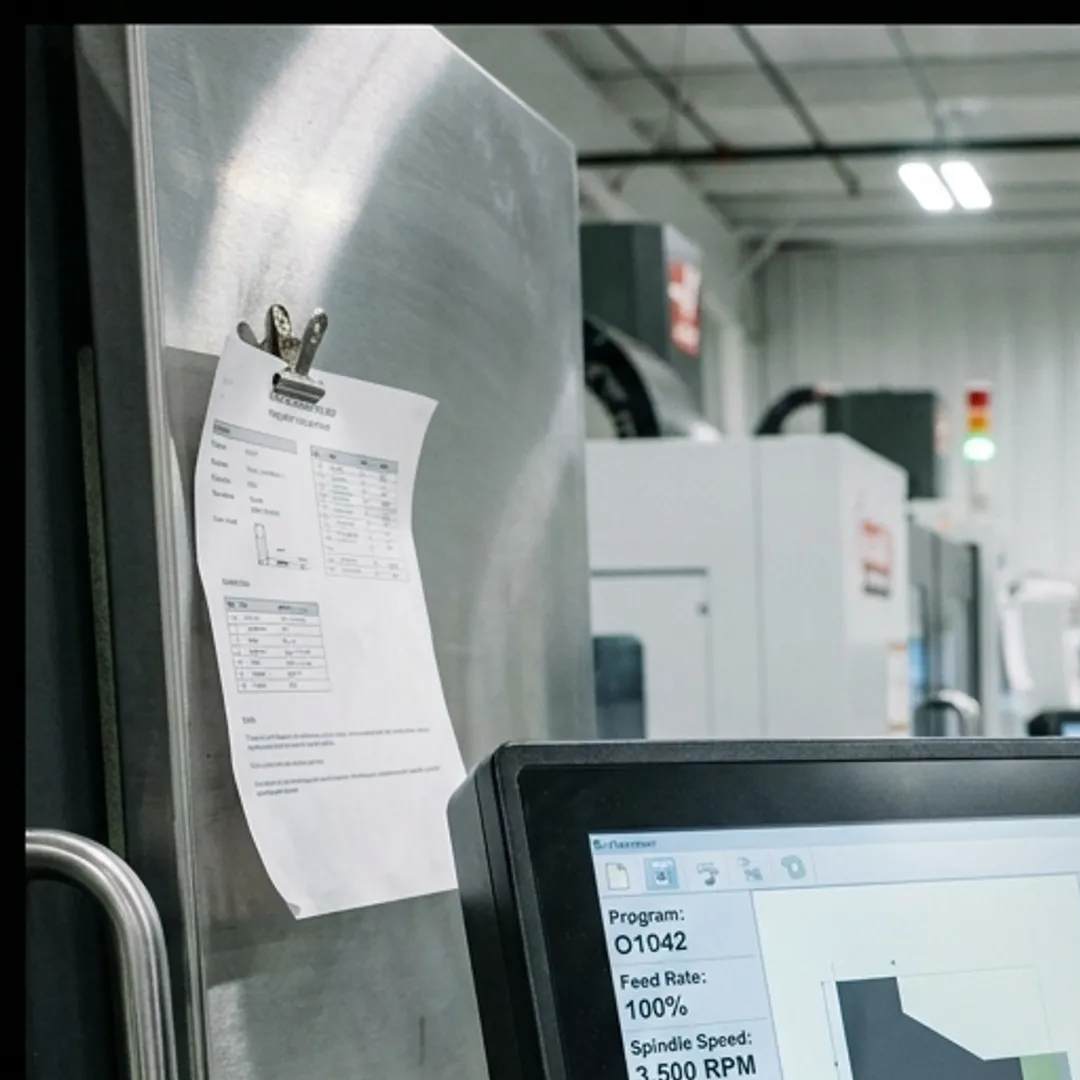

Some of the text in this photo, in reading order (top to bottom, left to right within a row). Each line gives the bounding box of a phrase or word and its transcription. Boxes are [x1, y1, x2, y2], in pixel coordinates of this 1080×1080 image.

[608, 907, 685, 927] Program:
[619, 970, 707, 990] Feed Rate:
[624, 994, 688, 1020] 100%
[696, 1031, 753, 1050] Speed:
[704, 1055, 757, 1080] RPM
